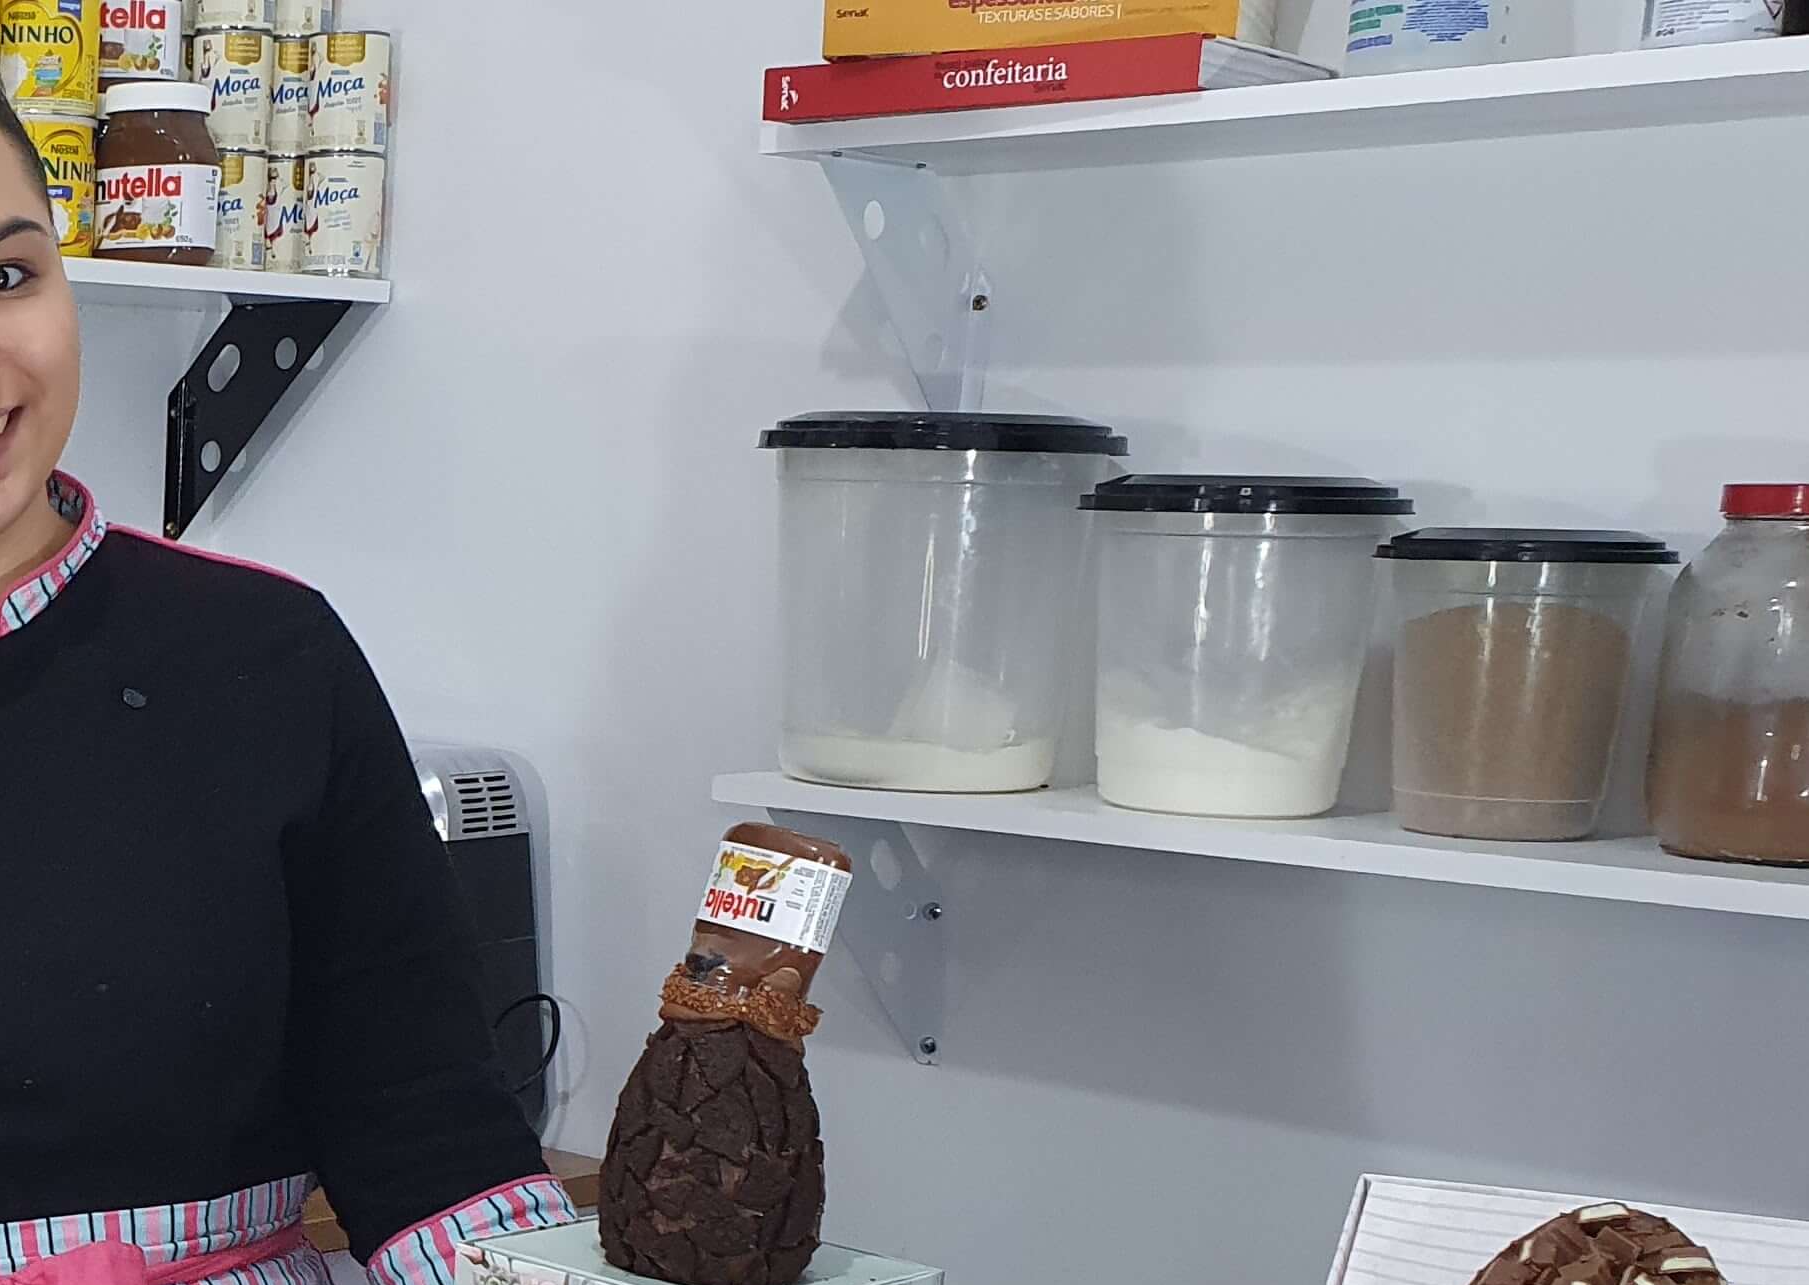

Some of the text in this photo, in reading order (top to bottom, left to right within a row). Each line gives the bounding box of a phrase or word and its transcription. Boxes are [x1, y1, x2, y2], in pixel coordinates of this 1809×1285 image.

[99, 0, 166, 29] tella
[978, 8, 1041, 25] TEXTURAS
[1054, 5, 1116, 20] SABORES
[0, 23, 74, 45] NINHO
[942, 57, 1068, 88] confeitaria
[214, 76, 261, 97] Moça
[317, 76, 365, 98] Moça
[41, 157, 95, 182] NINH
[95, 168, 182, 201] nutella
[313, 186, 359, 208] Moça
[705, 888, 775, 922] nutella
